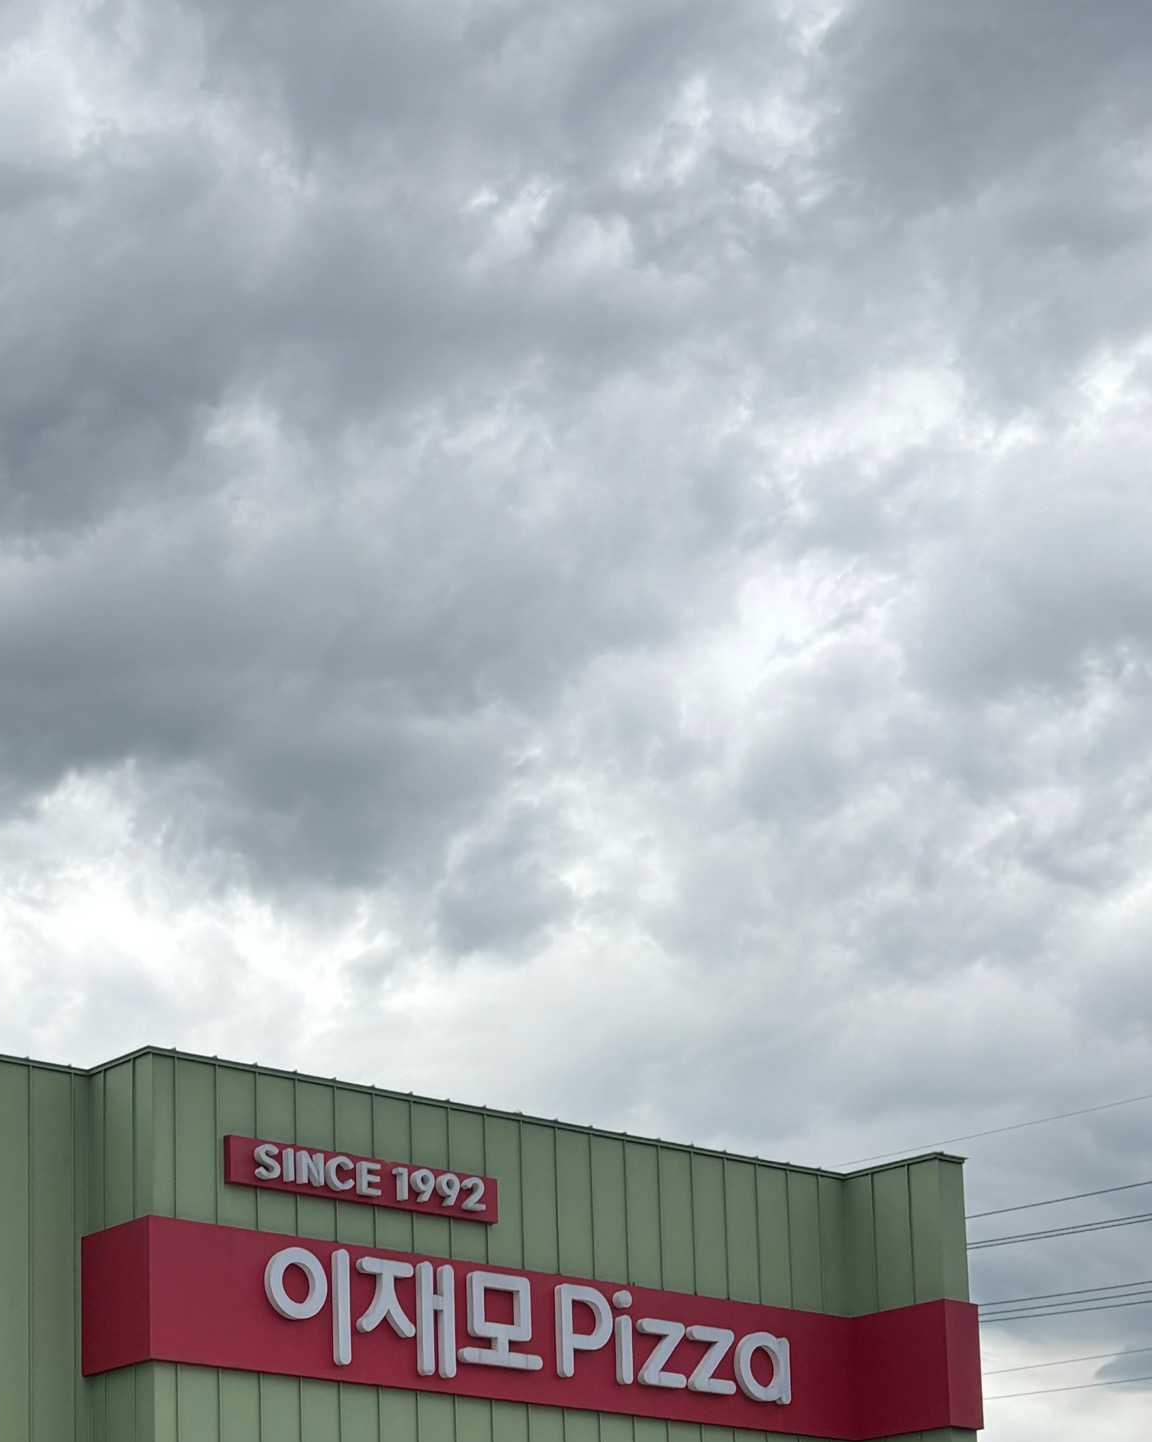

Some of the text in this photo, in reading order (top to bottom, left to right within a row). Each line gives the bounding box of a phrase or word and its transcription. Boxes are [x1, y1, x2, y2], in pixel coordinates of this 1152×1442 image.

[254, 1144, 487, 1212] SINCE 1992
[264, 1246, 792, 1405] 이재모 Pizza
